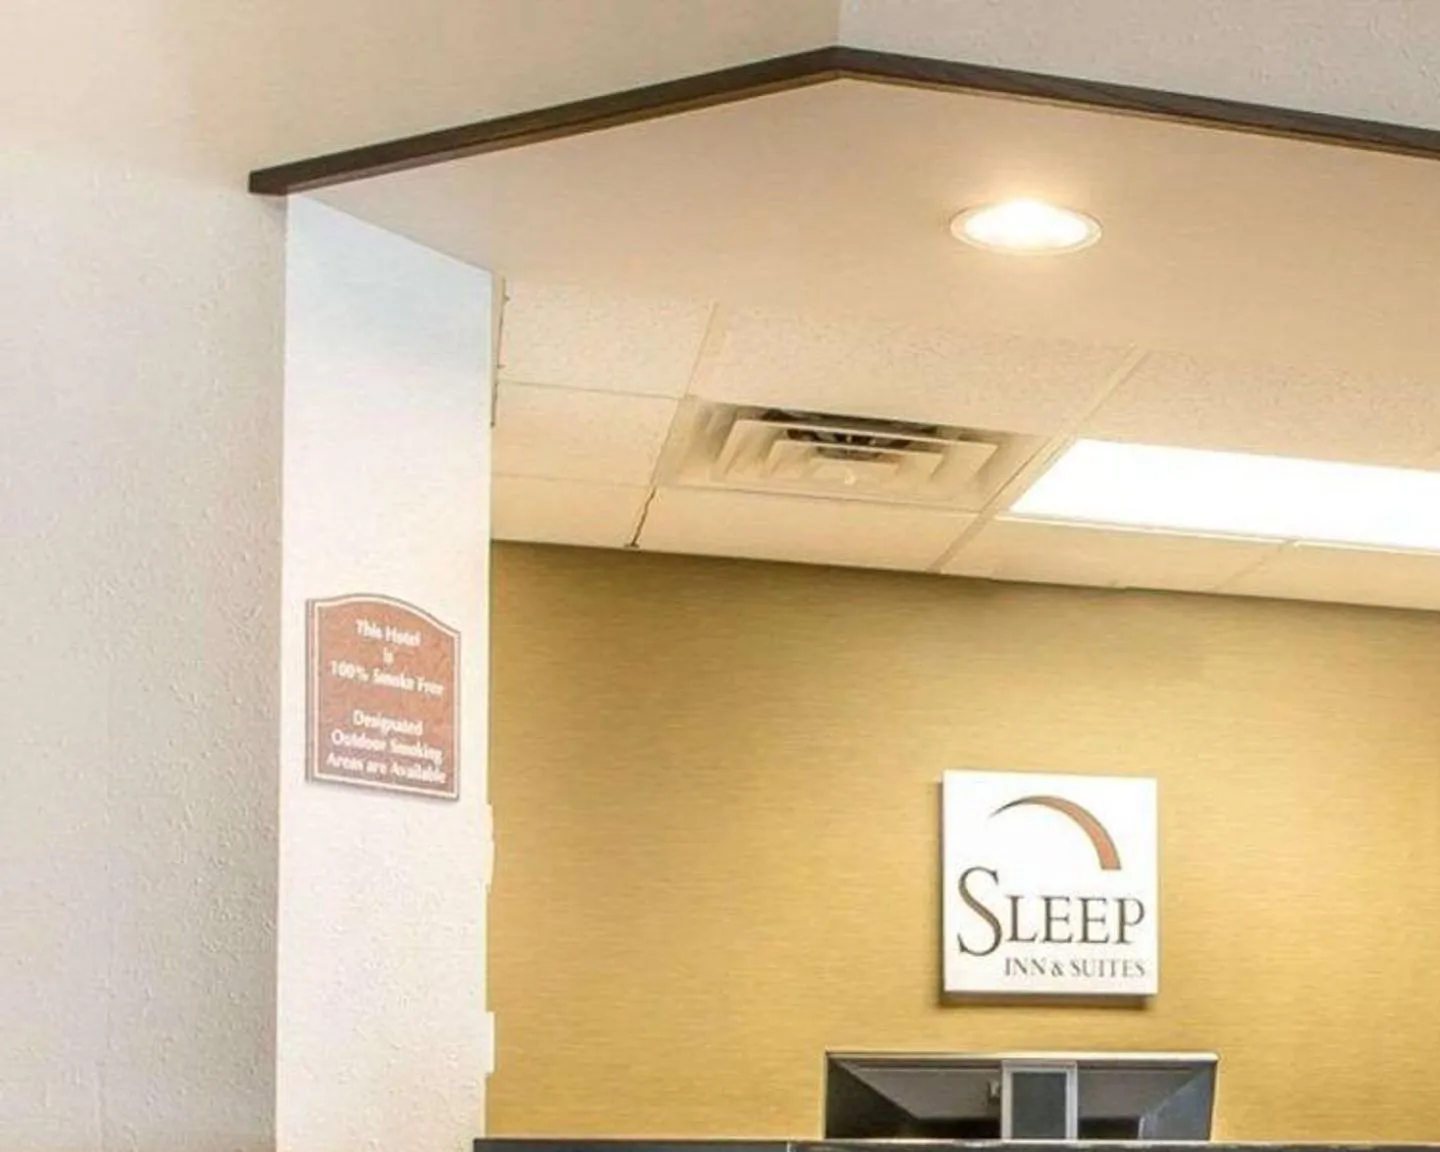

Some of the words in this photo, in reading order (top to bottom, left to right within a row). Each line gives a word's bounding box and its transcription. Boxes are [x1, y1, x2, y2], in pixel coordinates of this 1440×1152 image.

[331, 659, 369, 682] 100%
[1004, 957, 1046, 977] INN
[1049, 961, 1064, 977] &
[1070, 959, 1146, 978] SUITES
